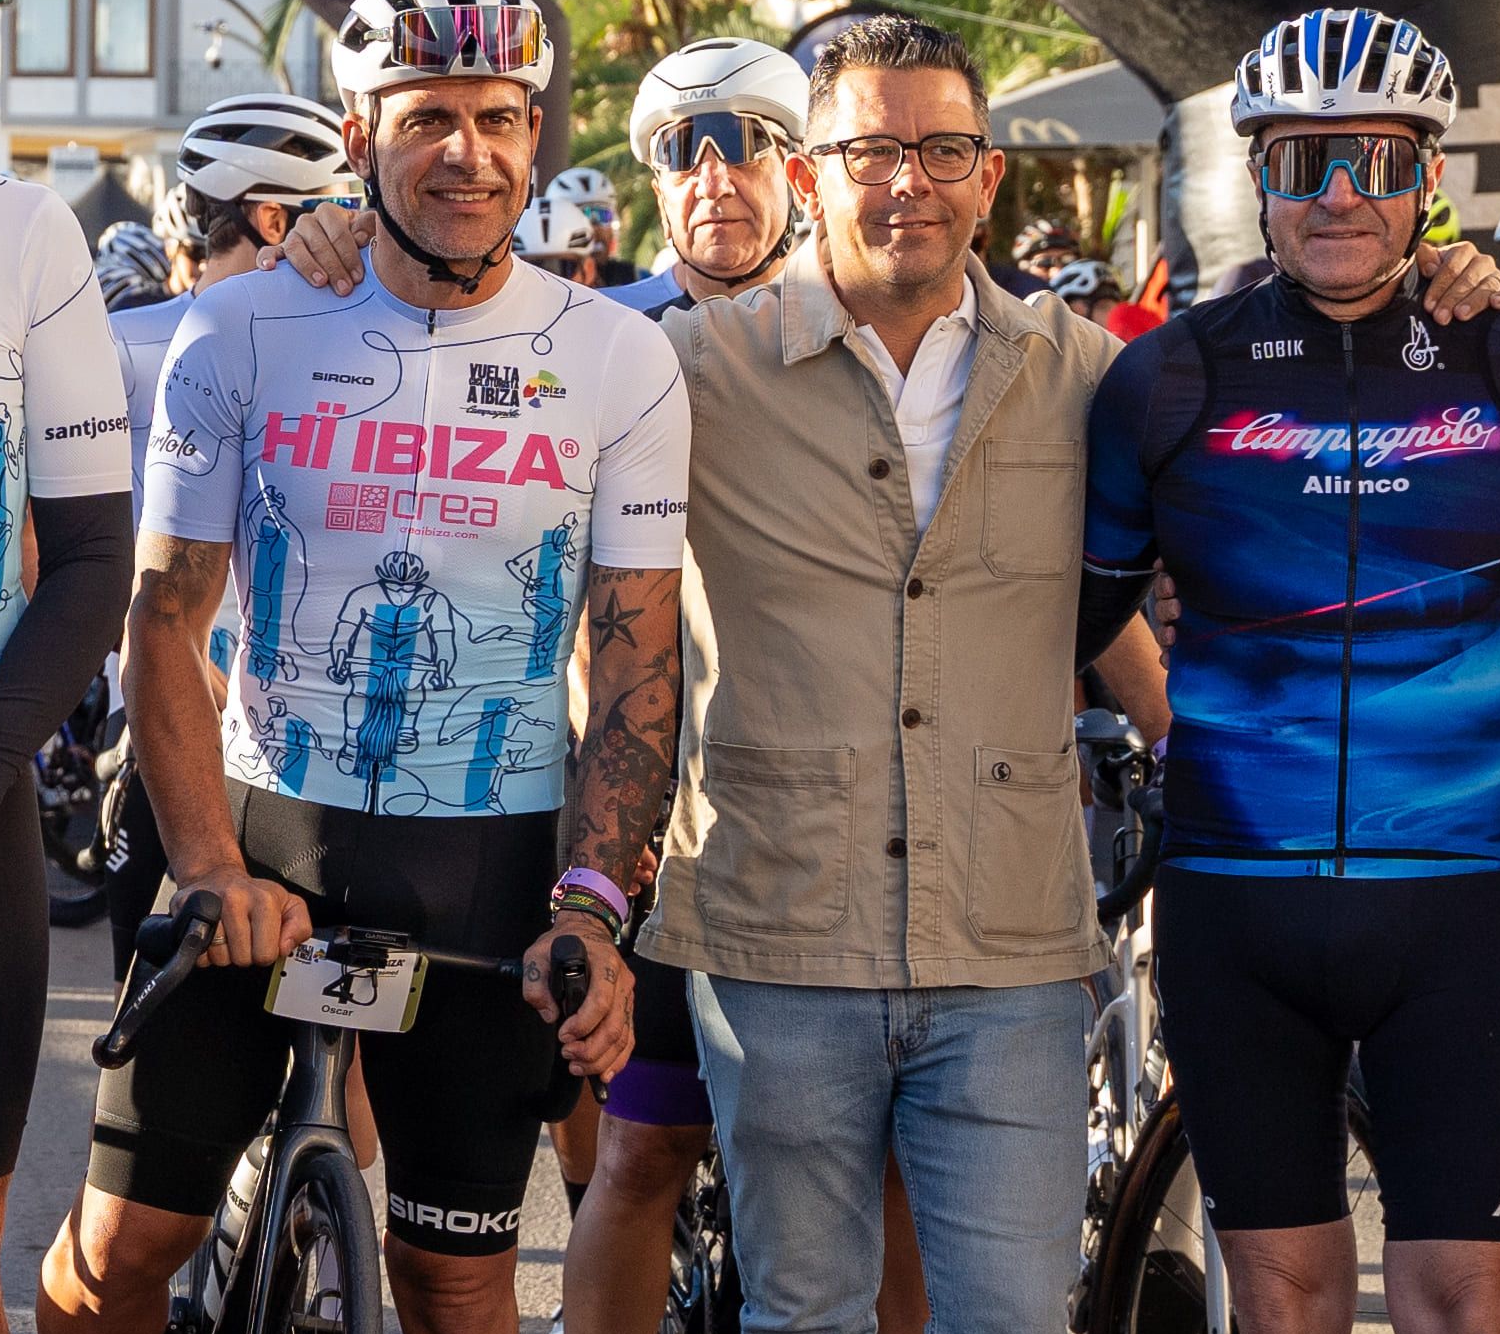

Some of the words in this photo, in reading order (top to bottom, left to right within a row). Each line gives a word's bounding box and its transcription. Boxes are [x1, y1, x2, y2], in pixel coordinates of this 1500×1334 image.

[678, 88, 719, 102] KASK
[1251, 340, 1304, 360] GOBIK
[311, 371, 375, 386] SIROKO
[469, 363, 520, 382] VUELTA
[467, 386, 477, 404] A
[481, 387, 520, 407] IBIZA
[261, 400, 347, 470] HÏ
[1208, 406, 1498, 467] Campagnolo
[391, 489, 498, 529] crea
[365, 932, 397, 942] GARMIN
[322, 973, 354, 1004] 4
[321, 1004, 354, 1017] Oscar
